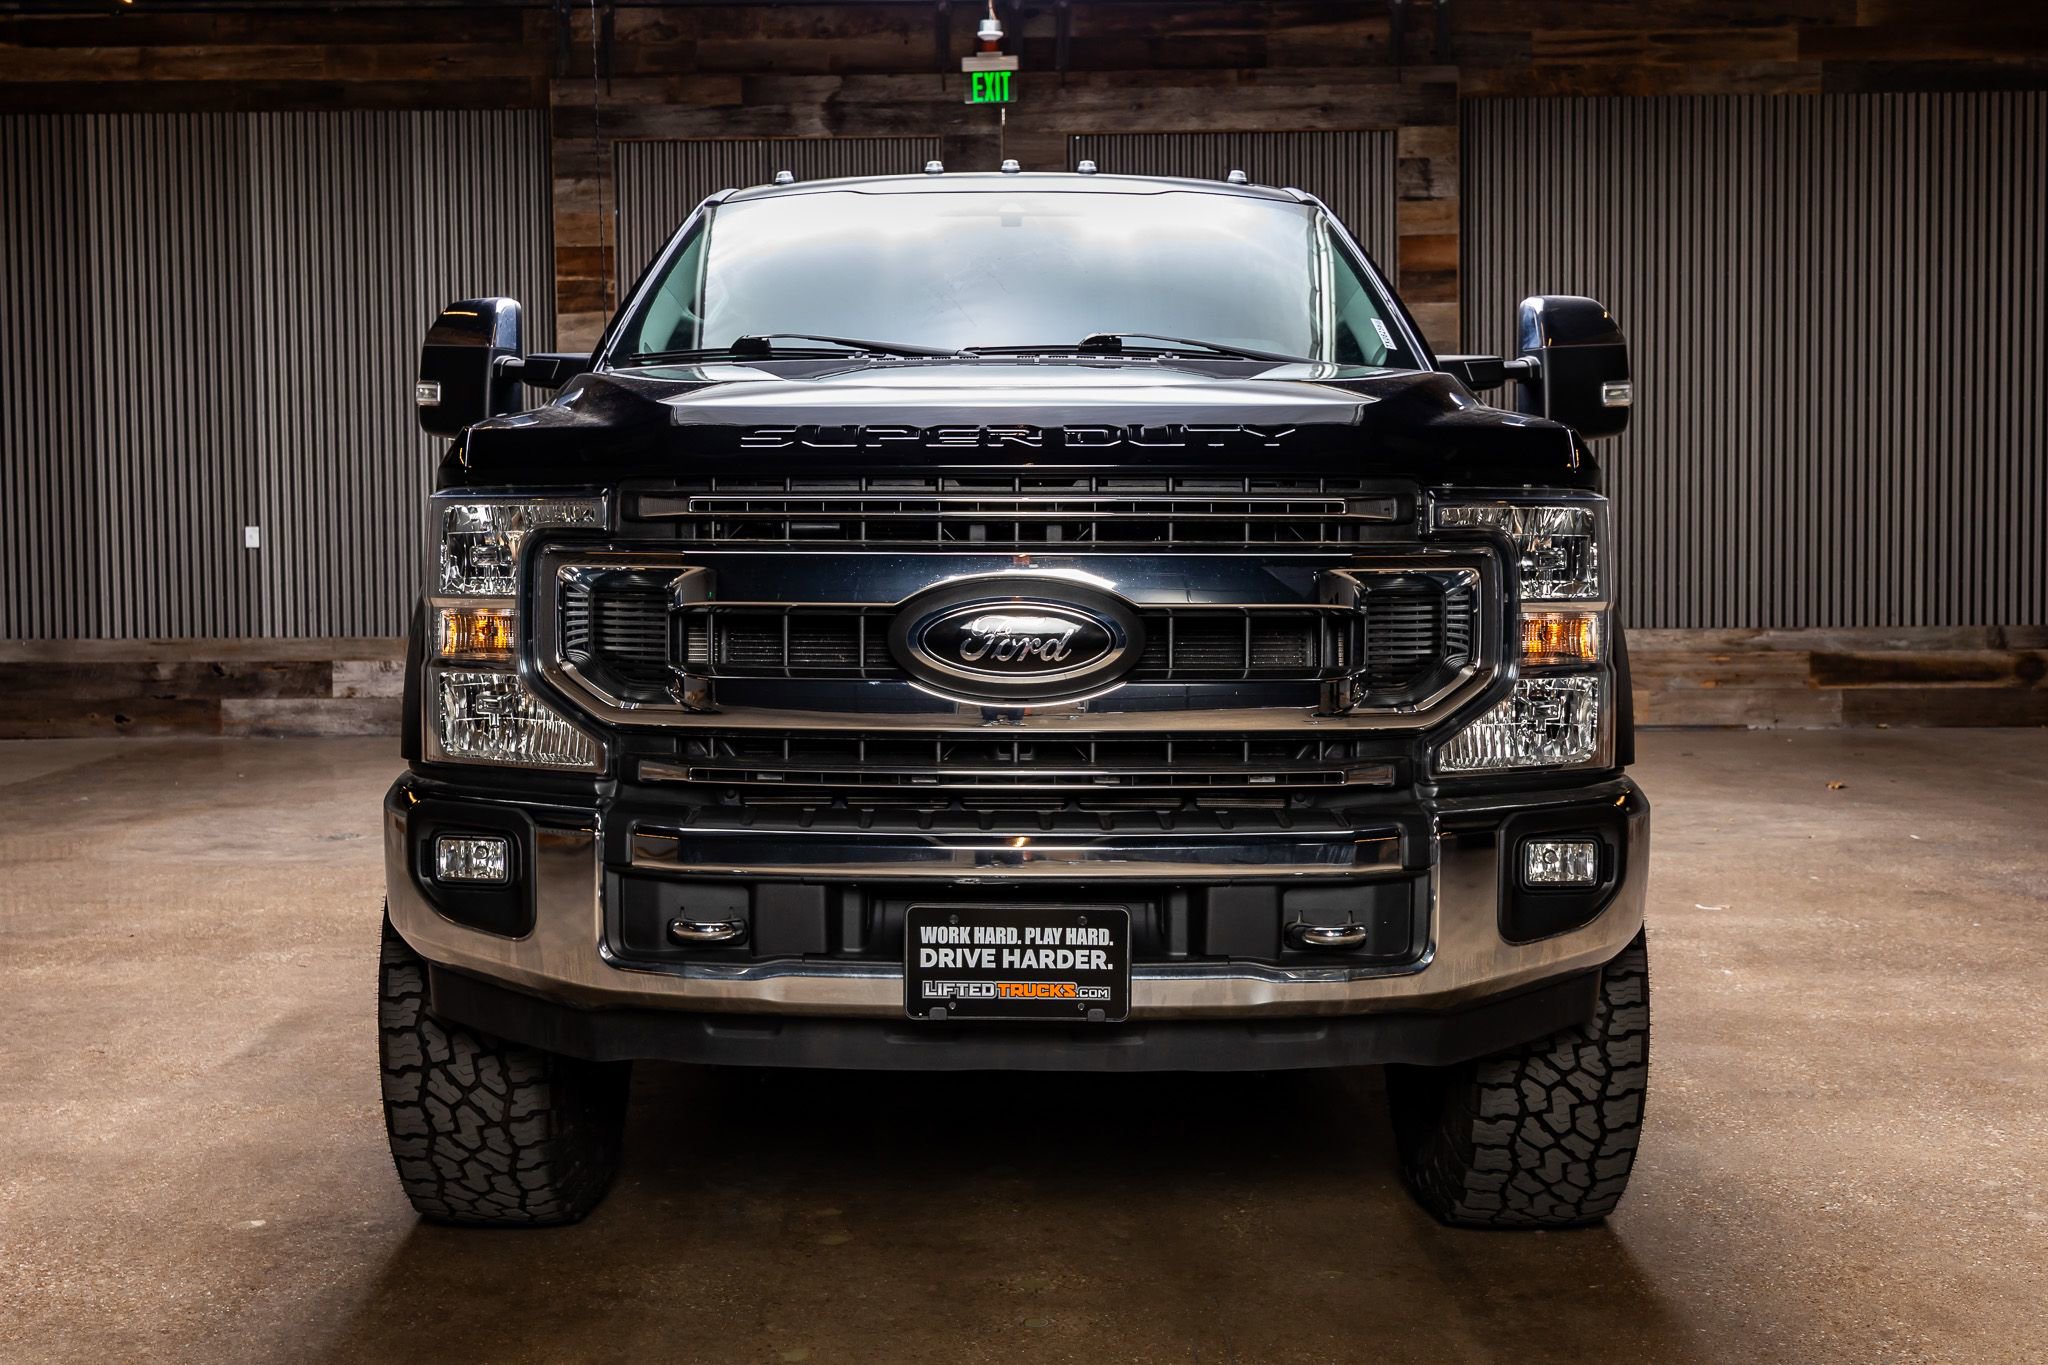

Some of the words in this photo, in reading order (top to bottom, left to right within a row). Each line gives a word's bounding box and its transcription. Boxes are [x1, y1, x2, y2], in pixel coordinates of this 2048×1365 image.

[972, 72, 1011, 102] EXIT
[740, 425, 1042, 447] SUPER
[1063, 424, 1296, 446] DUTY
[960, 615, 1073, 662] Ford
[920, 926, 971, 945] WORK
[973, 927, 1022, 945] HARD.
[1025, 927, 1063, 945] PLAY
[1065, 928, 1114, 946] HARD.
[919, 948, 996, 969] DRIVE
[1002, 948, 1114, 970] HARDER.
[923, 981, 1111, 999] LIFTEDTRUCKS.COM
